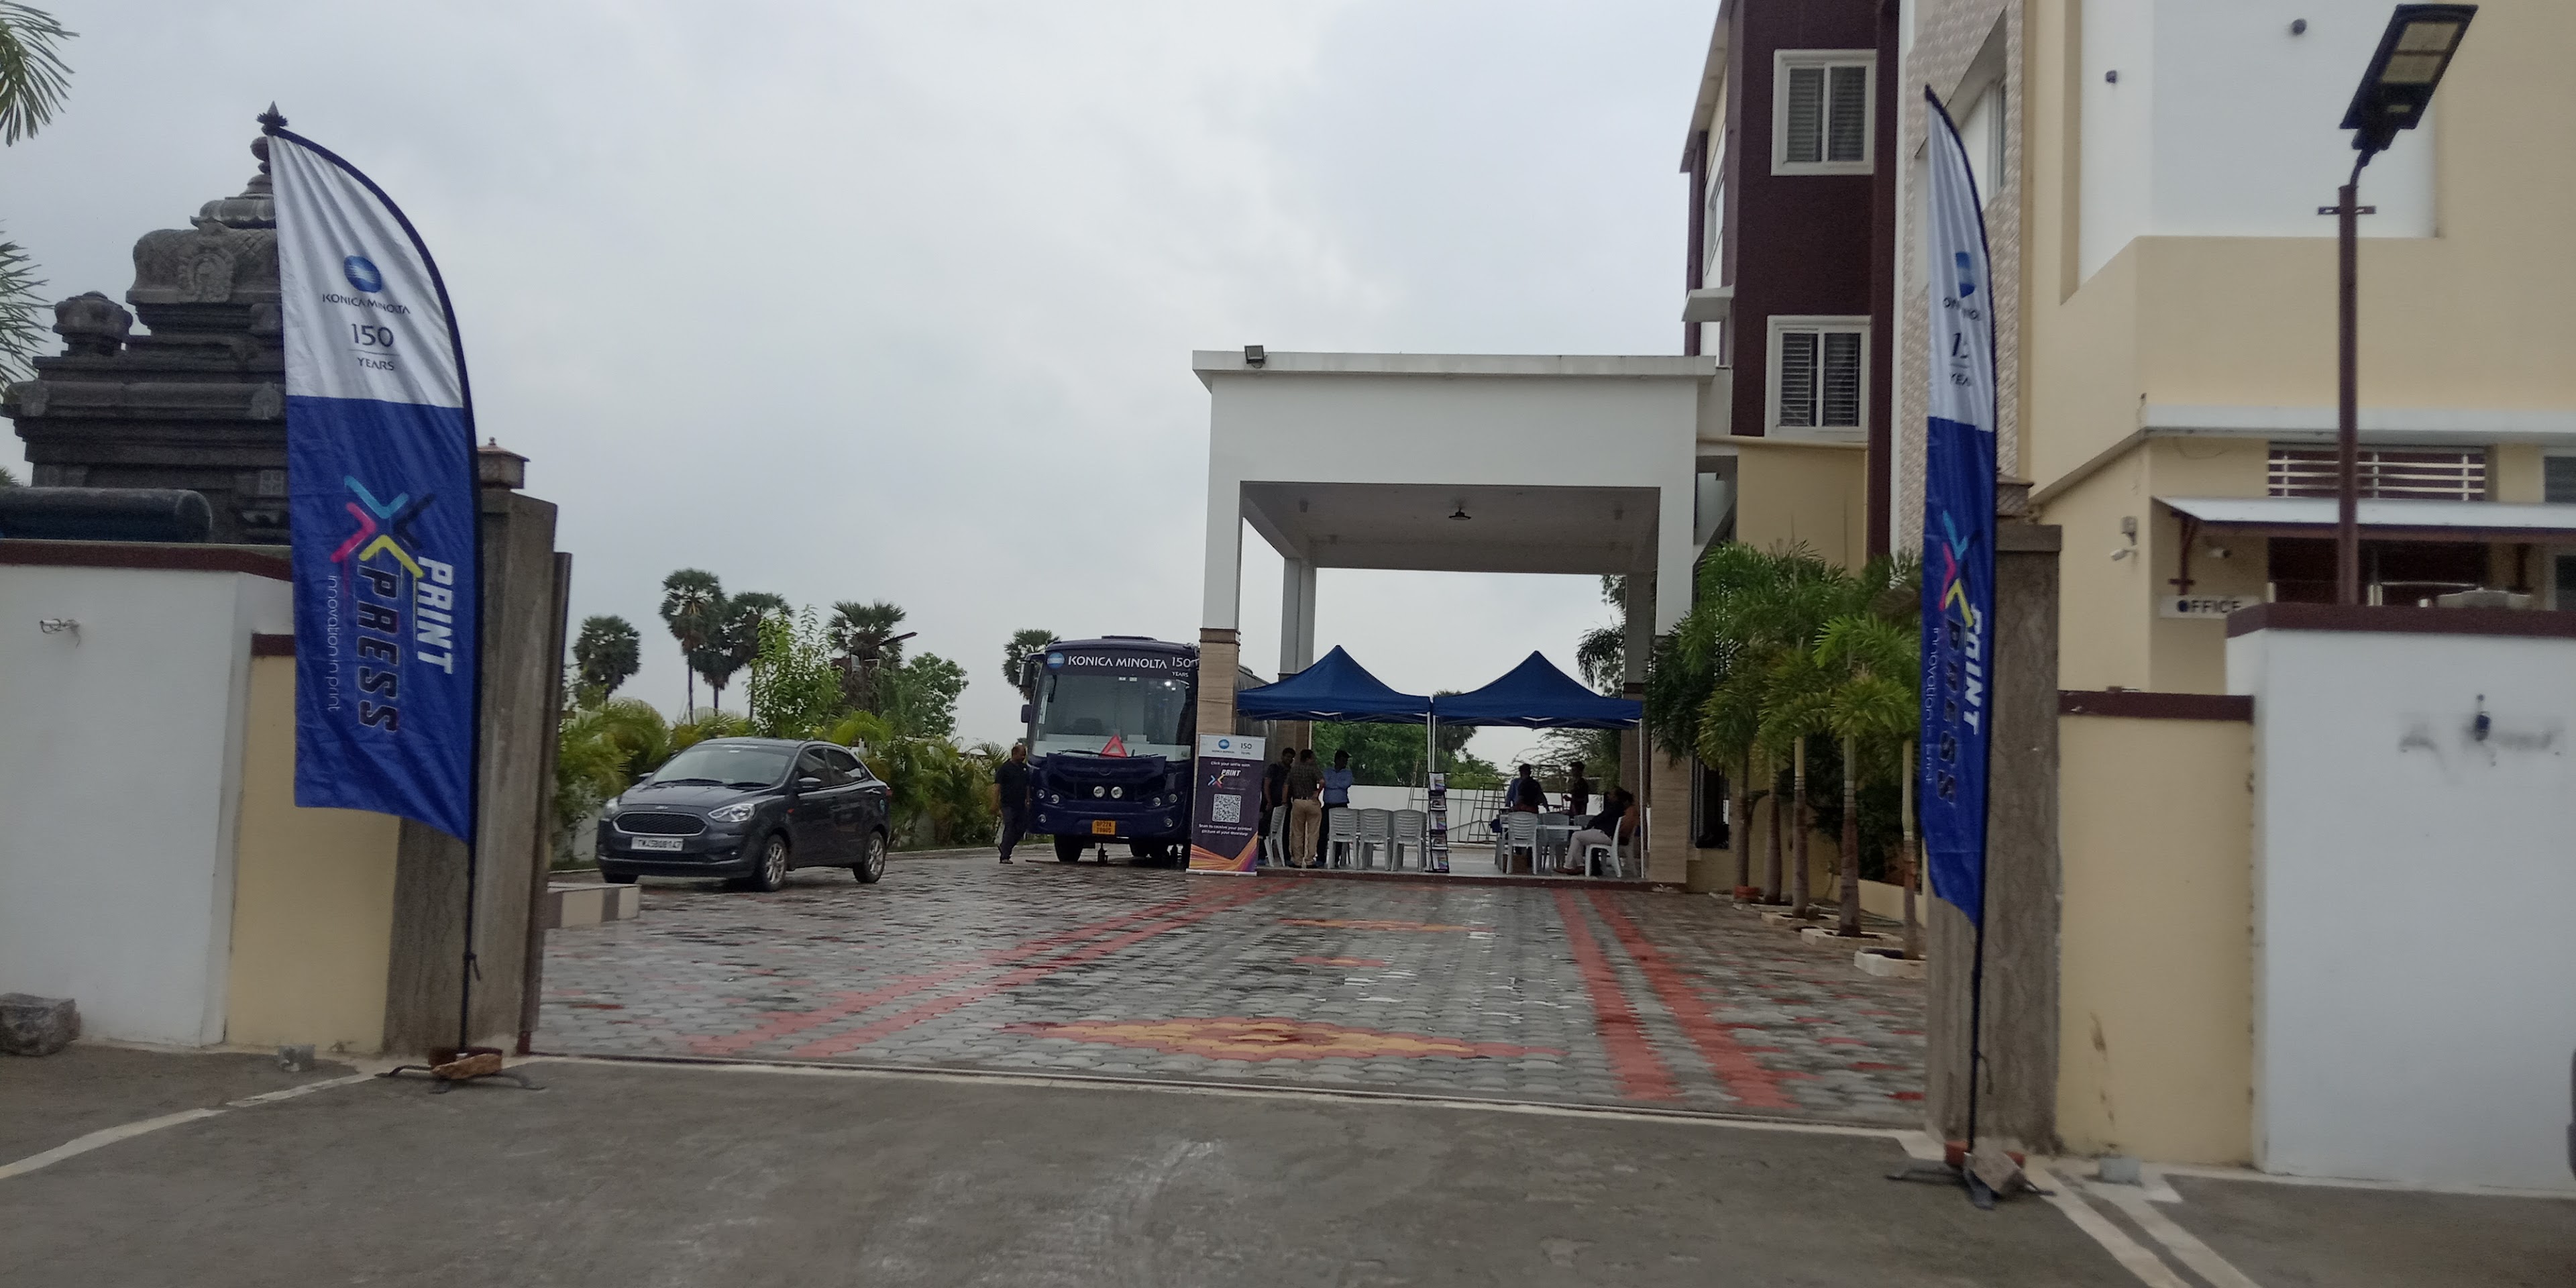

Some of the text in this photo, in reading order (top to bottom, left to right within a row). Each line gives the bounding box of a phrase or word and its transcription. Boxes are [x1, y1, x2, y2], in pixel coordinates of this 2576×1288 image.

[323, 294, 411, 314] KONICA MINOLTA
[351, 323, 394, 347] 150
[357, 357, 394, 371] YEARS
[417, 556, 455, 675] PRINT
[326, 574, 341, 712] innovation in print
[1068, 655, 1191, 669] KONICA MINOLTA 150
[1925, 627, 1940, 722] innovation
